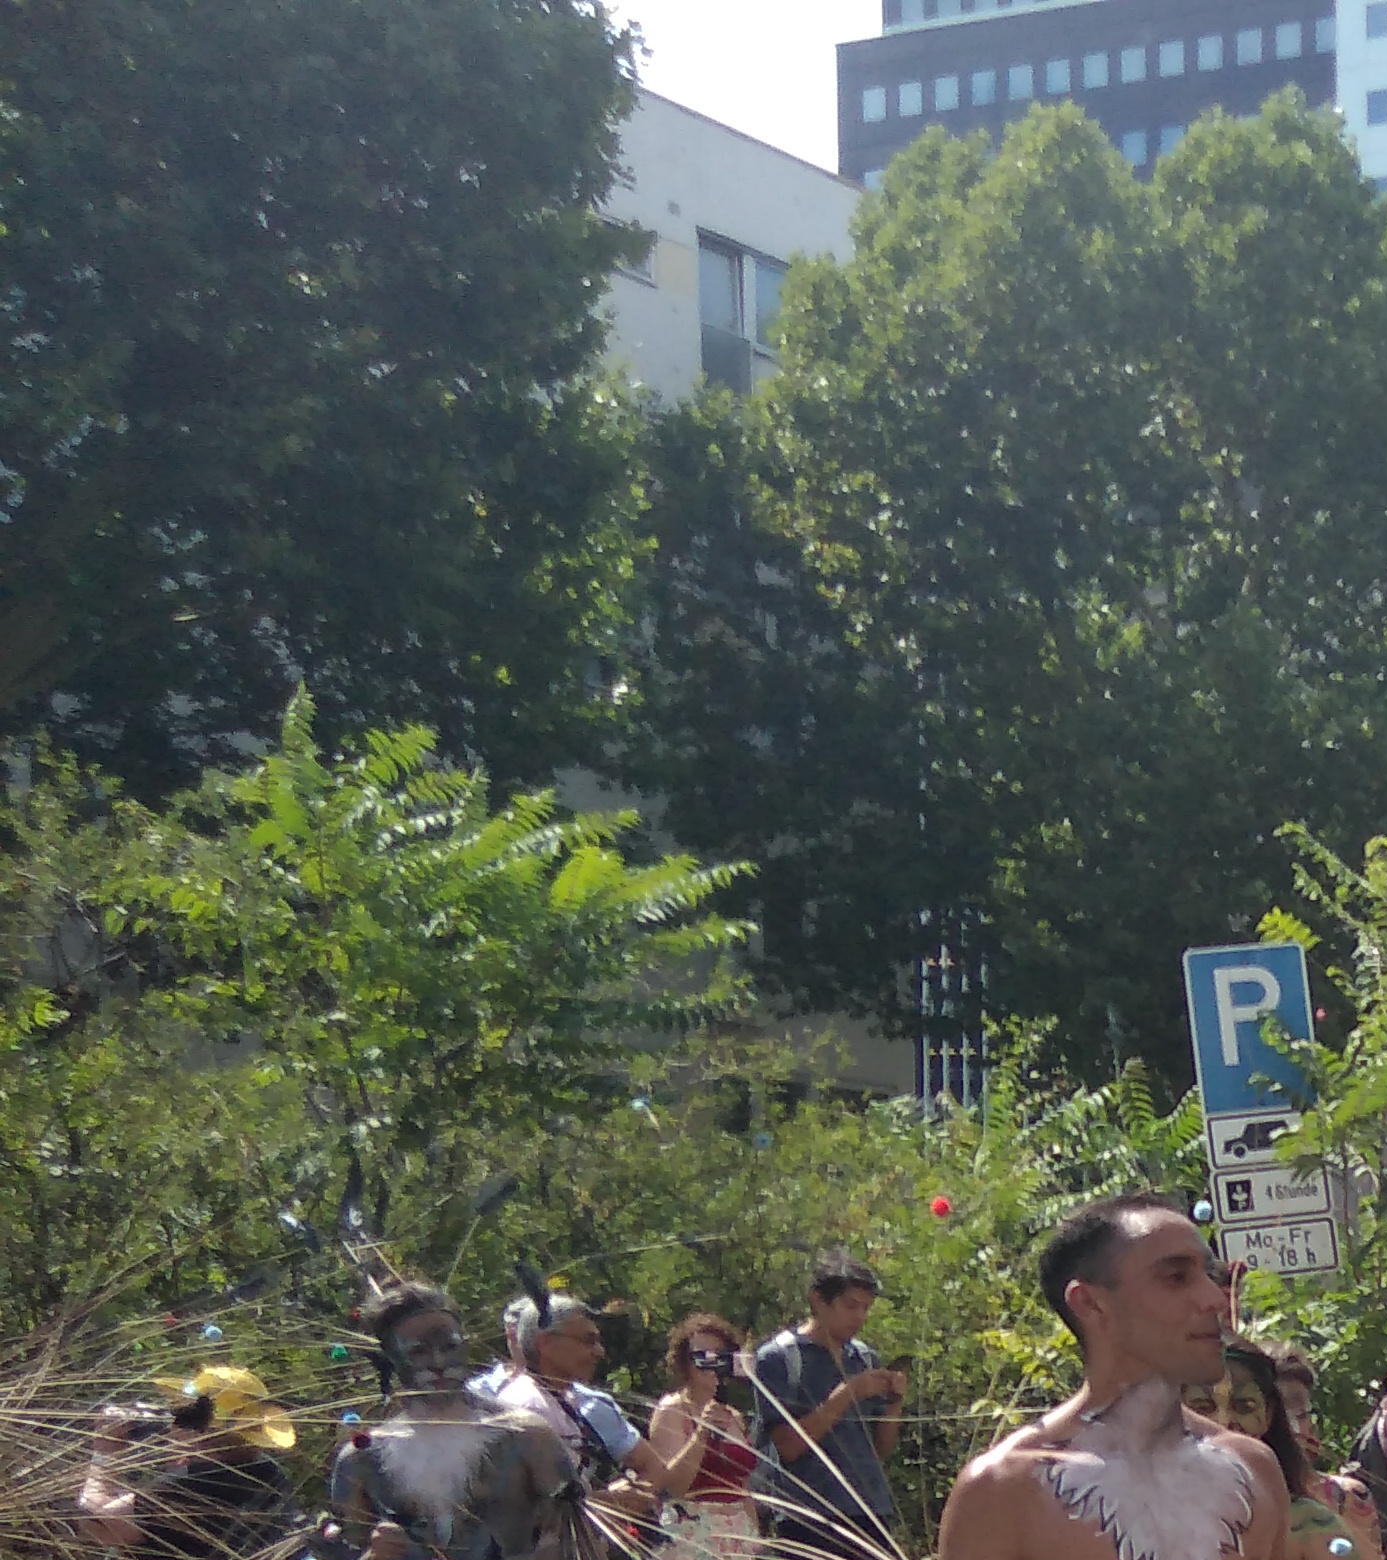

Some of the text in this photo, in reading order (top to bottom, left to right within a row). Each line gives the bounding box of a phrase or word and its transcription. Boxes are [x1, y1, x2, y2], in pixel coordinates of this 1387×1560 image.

[1212, 964, 1281, 1067] P
[1274, 1178, 1318, 1200] Stunde
[1246, 1231, 1273, 1249] Mo
[1288, 1227, 1312, 1245] Fr
[1246, 1254, 1259, 1271] 9
[1278, 1244, 1298, 1267] 18
[1305, 1246, 1317, 1265] h
